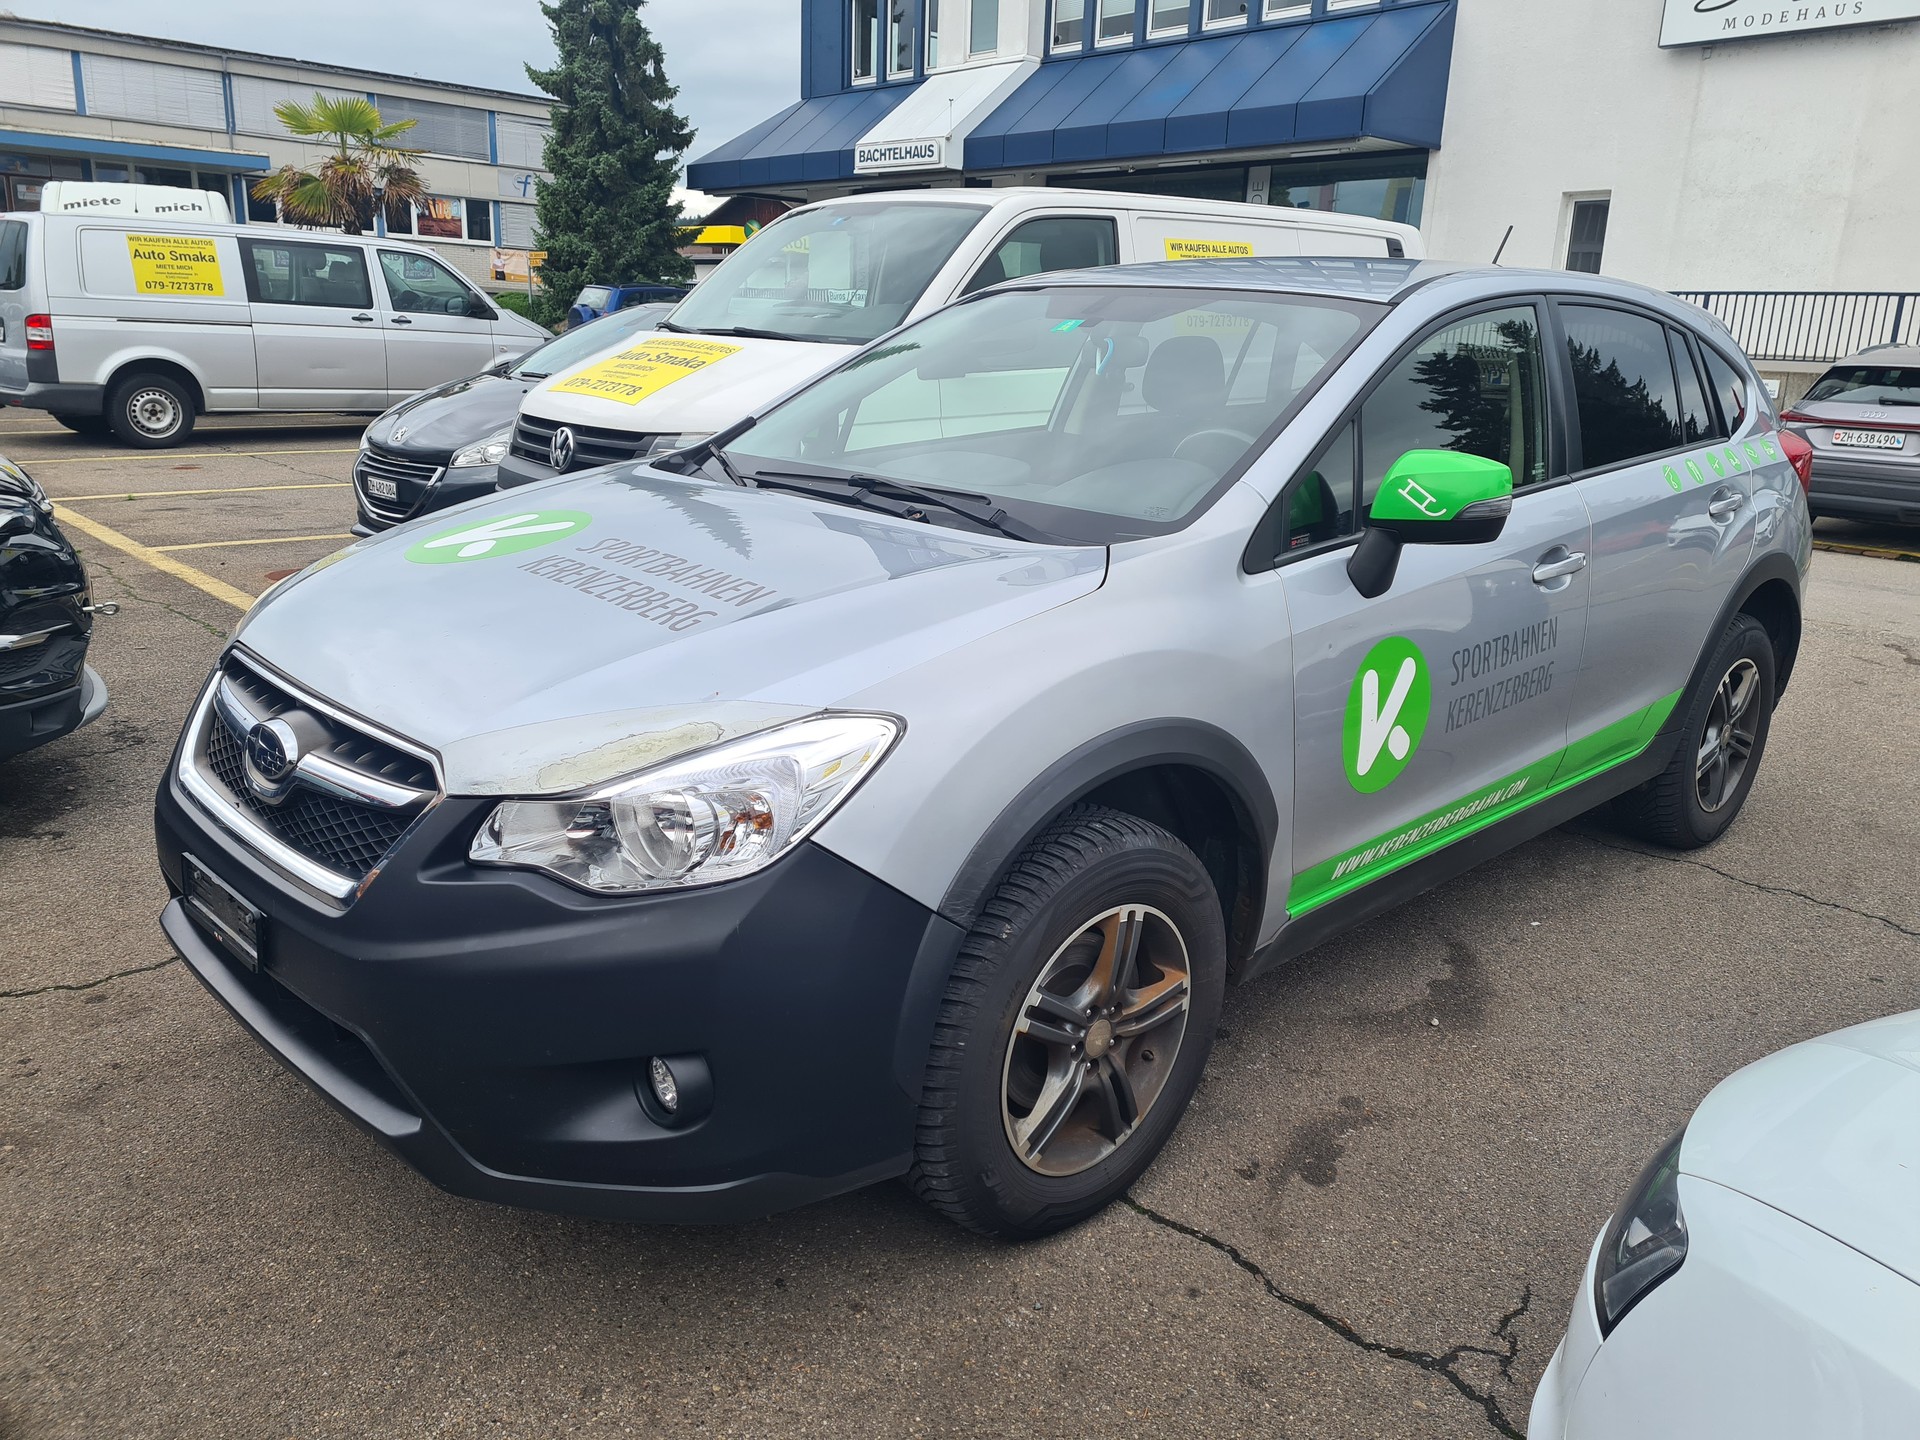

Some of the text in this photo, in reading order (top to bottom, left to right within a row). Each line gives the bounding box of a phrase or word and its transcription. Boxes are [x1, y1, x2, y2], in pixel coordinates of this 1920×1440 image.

[1722, 2, 1864, 31] MODEHAUS
[859, 144, 935, 163] BACHTELHAUS
[63, 196, 203, 214] miete mich
[143, 236, 172, 244] KAUFEN
[190, 239, 214, 247] AUTOS
[1170, 243, 1249, 255] WIR KAUFEN ALLE AUTOS
[133, 248, 216, 263] Auto Smaka
[145, 280, 214, 291] 079-7273778
[660, 339, 689, 349] KAUFEN
[685, 342, 710, 351] ALLE
[708, 344, 736, 354] AUTOS
[614, 350, 651, 362] Auto
[650, 352, 708, 370] Smaka
[564, 377, 643, 396] 079-7273778
[575, 537, 778, 607] SPORTBAHNEN
[517, 554, 718, 632] KERENZERBERG
[1450, 616, 1558, 687] SPORTBAHNEN
[1445, 660, 1555, 734] KERENZERBERG
[1331, 776, 1531, 881] WWW.KERENZERBERGBAHN.COM
